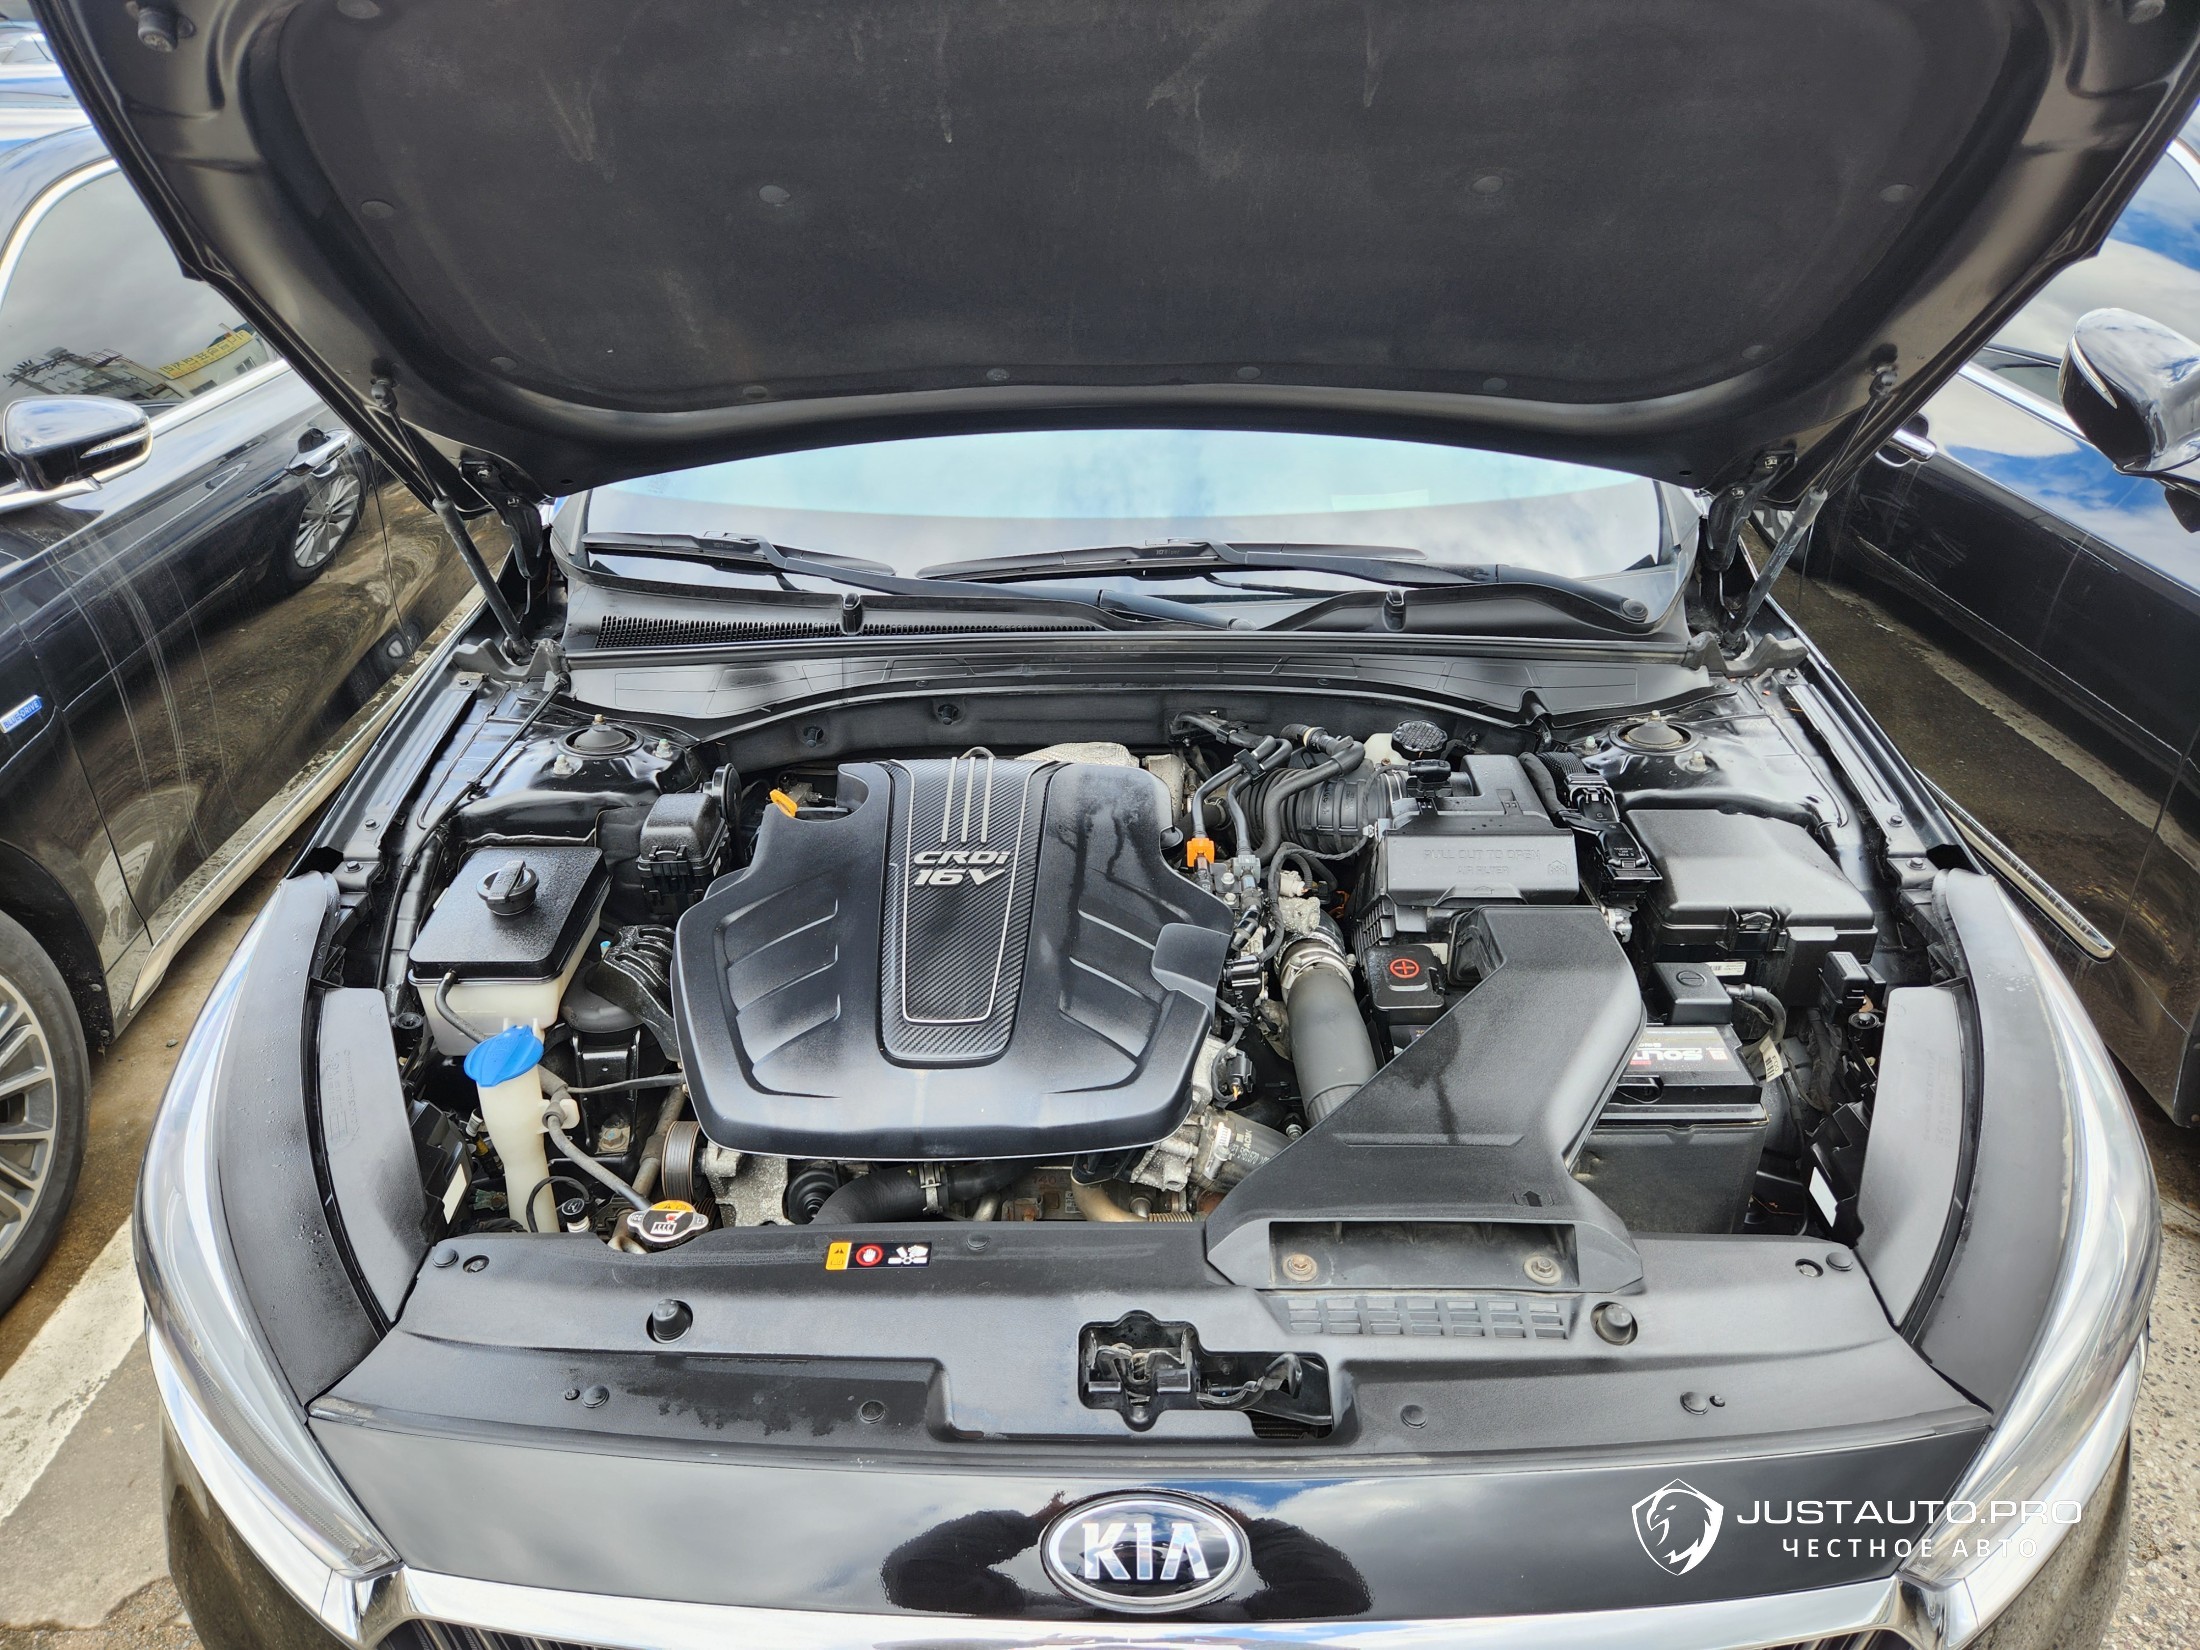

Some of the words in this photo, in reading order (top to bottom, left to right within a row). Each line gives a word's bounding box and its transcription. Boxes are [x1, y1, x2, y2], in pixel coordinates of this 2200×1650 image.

[3, 711, 21, 728] BLUE
[20, 700, 39, 718] DRIVE
[913, 851, 1012, 866] CRDi
[1424, 849, 1455, 859] PULL
[1508, 849, 1541, 861] OPEN
[914, 869, 1006, 887] 16V
[1631, 1049, 1703, 1061] SOLIT
[1082, 1522, 1210, 1580] KIA
